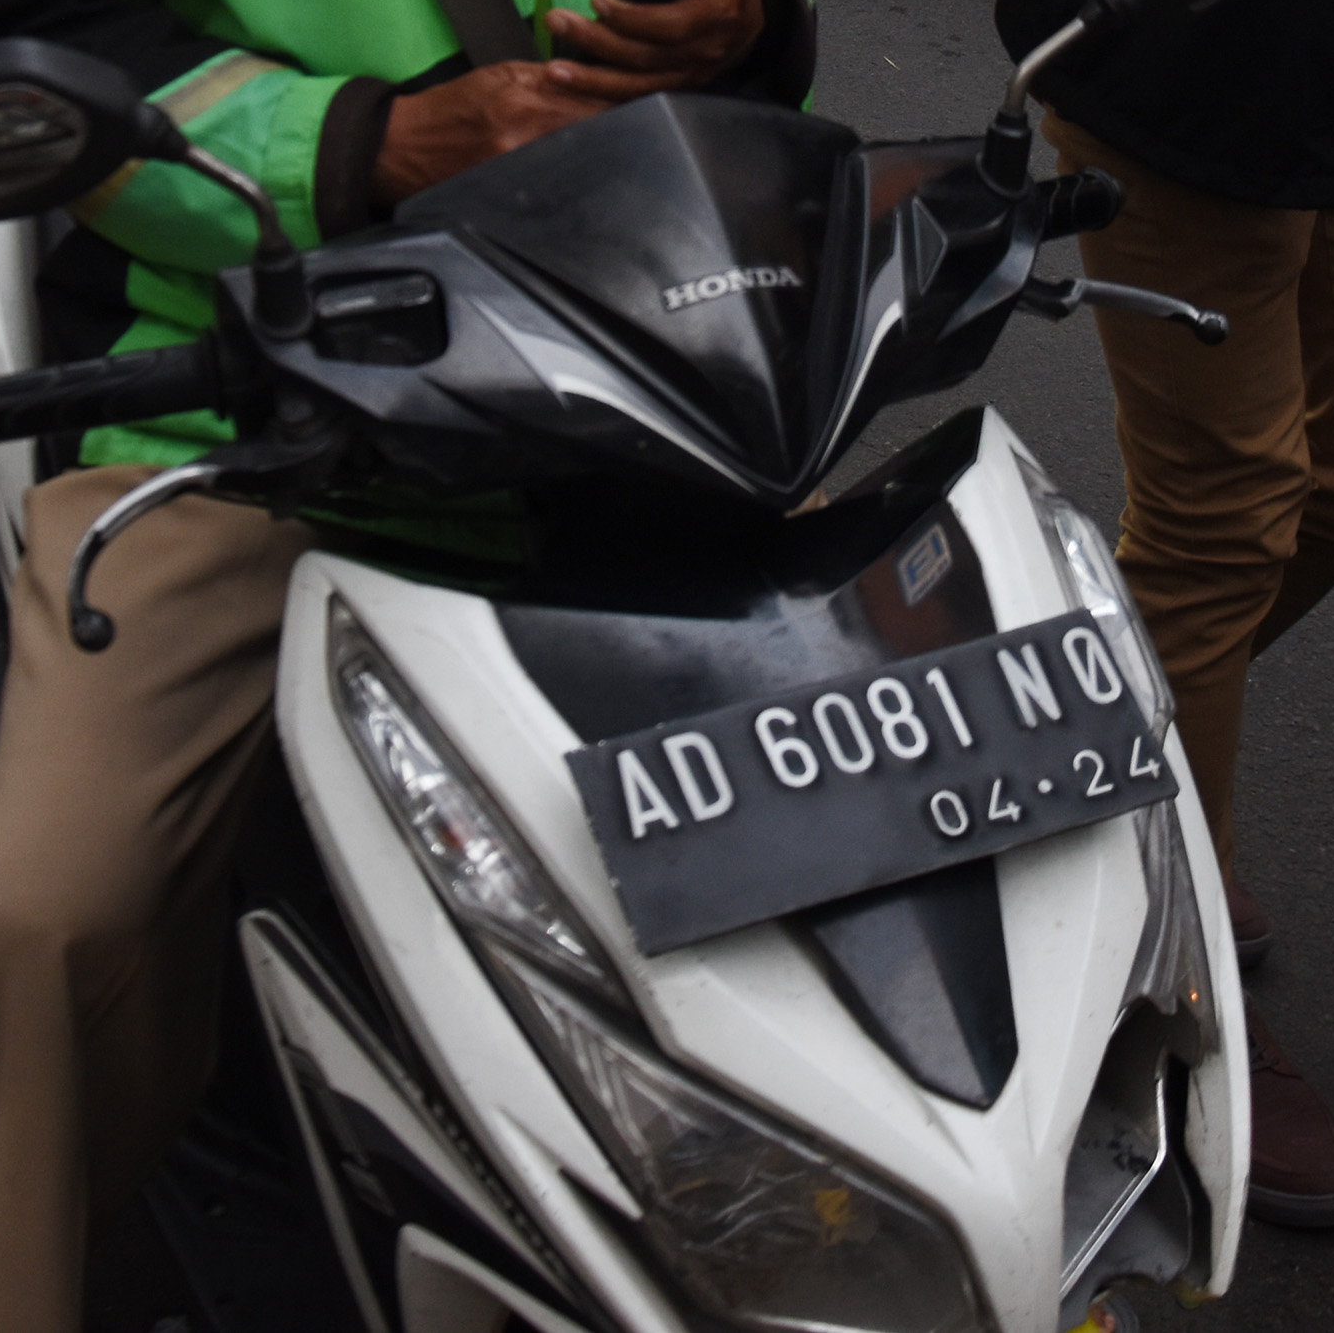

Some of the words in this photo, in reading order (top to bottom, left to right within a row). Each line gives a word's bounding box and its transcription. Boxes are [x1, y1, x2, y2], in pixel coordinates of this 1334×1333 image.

[664, 266, 803, 311] HONDA
[617, 731, 735, 839] AD
[754, 667, 973, 789] 6081
